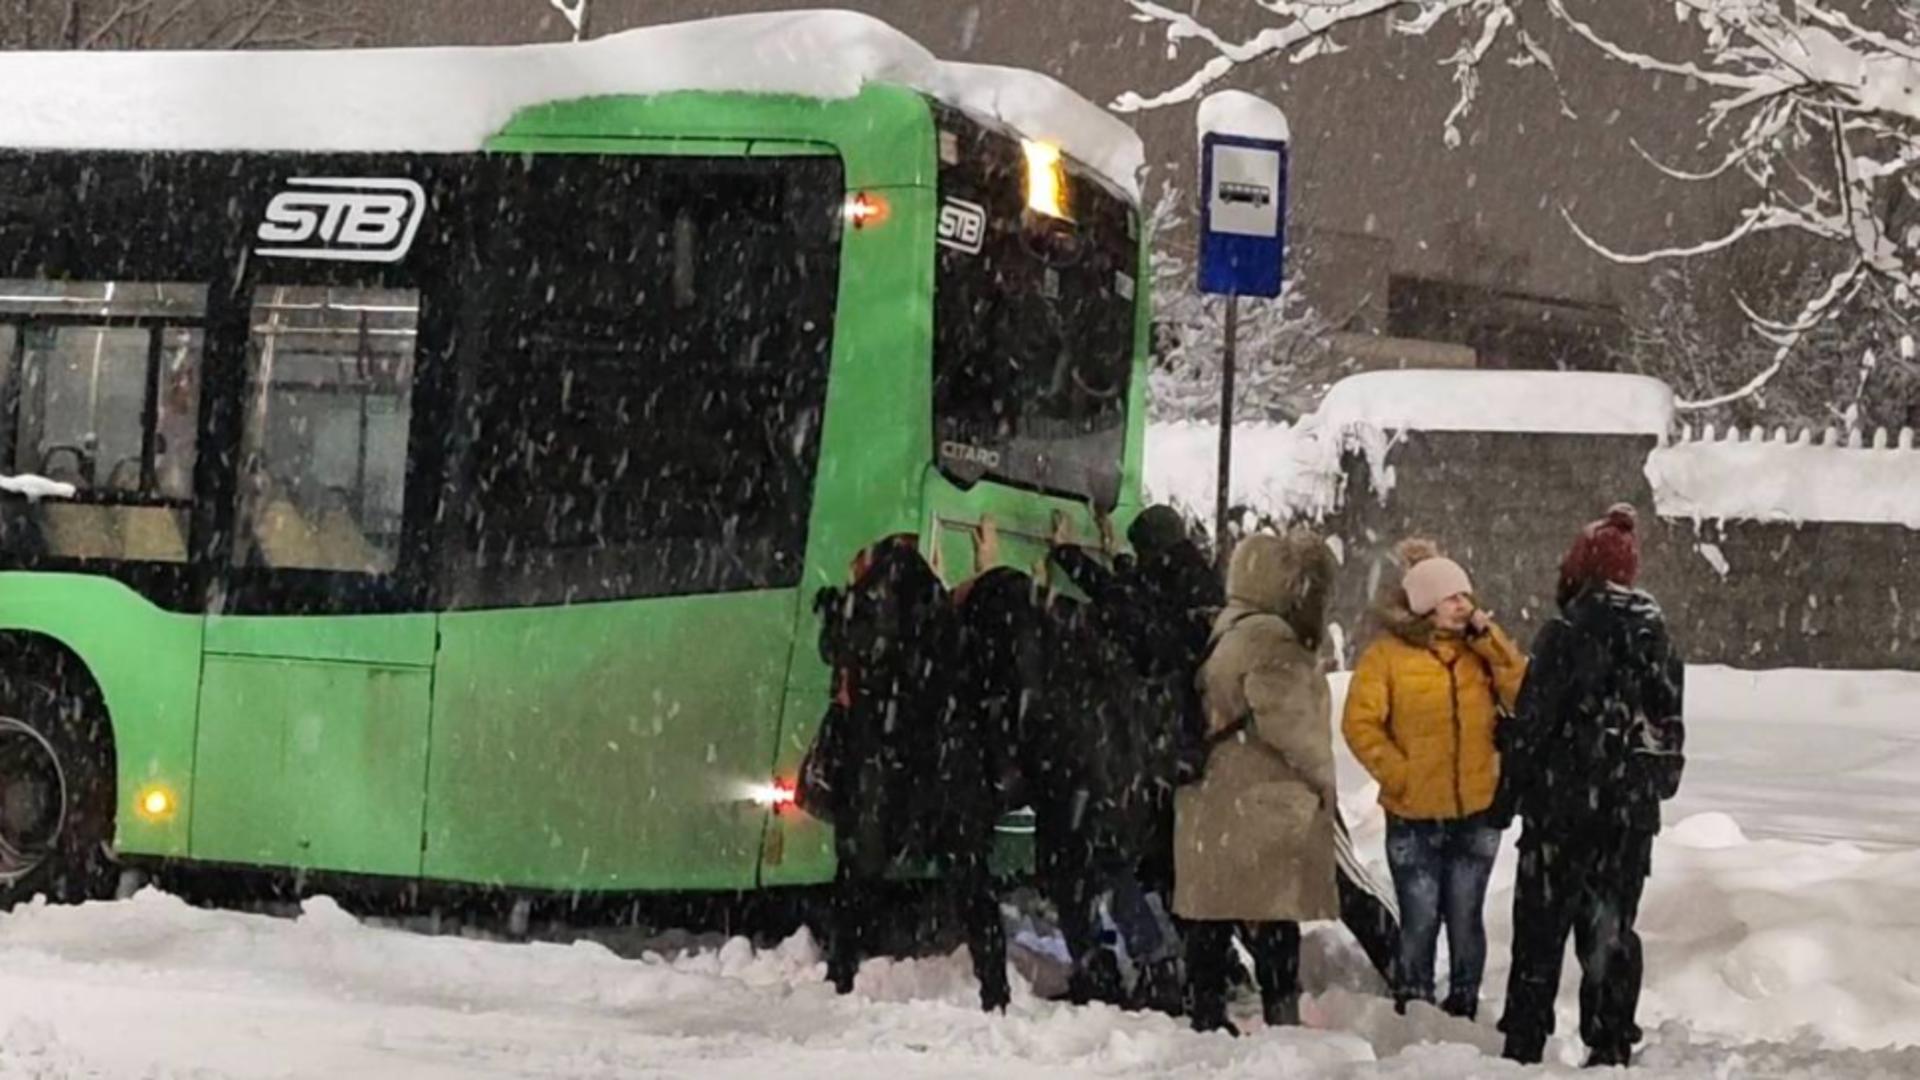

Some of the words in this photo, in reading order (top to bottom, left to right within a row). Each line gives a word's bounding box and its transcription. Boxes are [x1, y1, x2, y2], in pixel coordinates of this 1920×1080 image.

[257, 191, 408, 244] STB
[938, 205, 980, 243] STB
[941, 441, 1000, 468] CITARO
